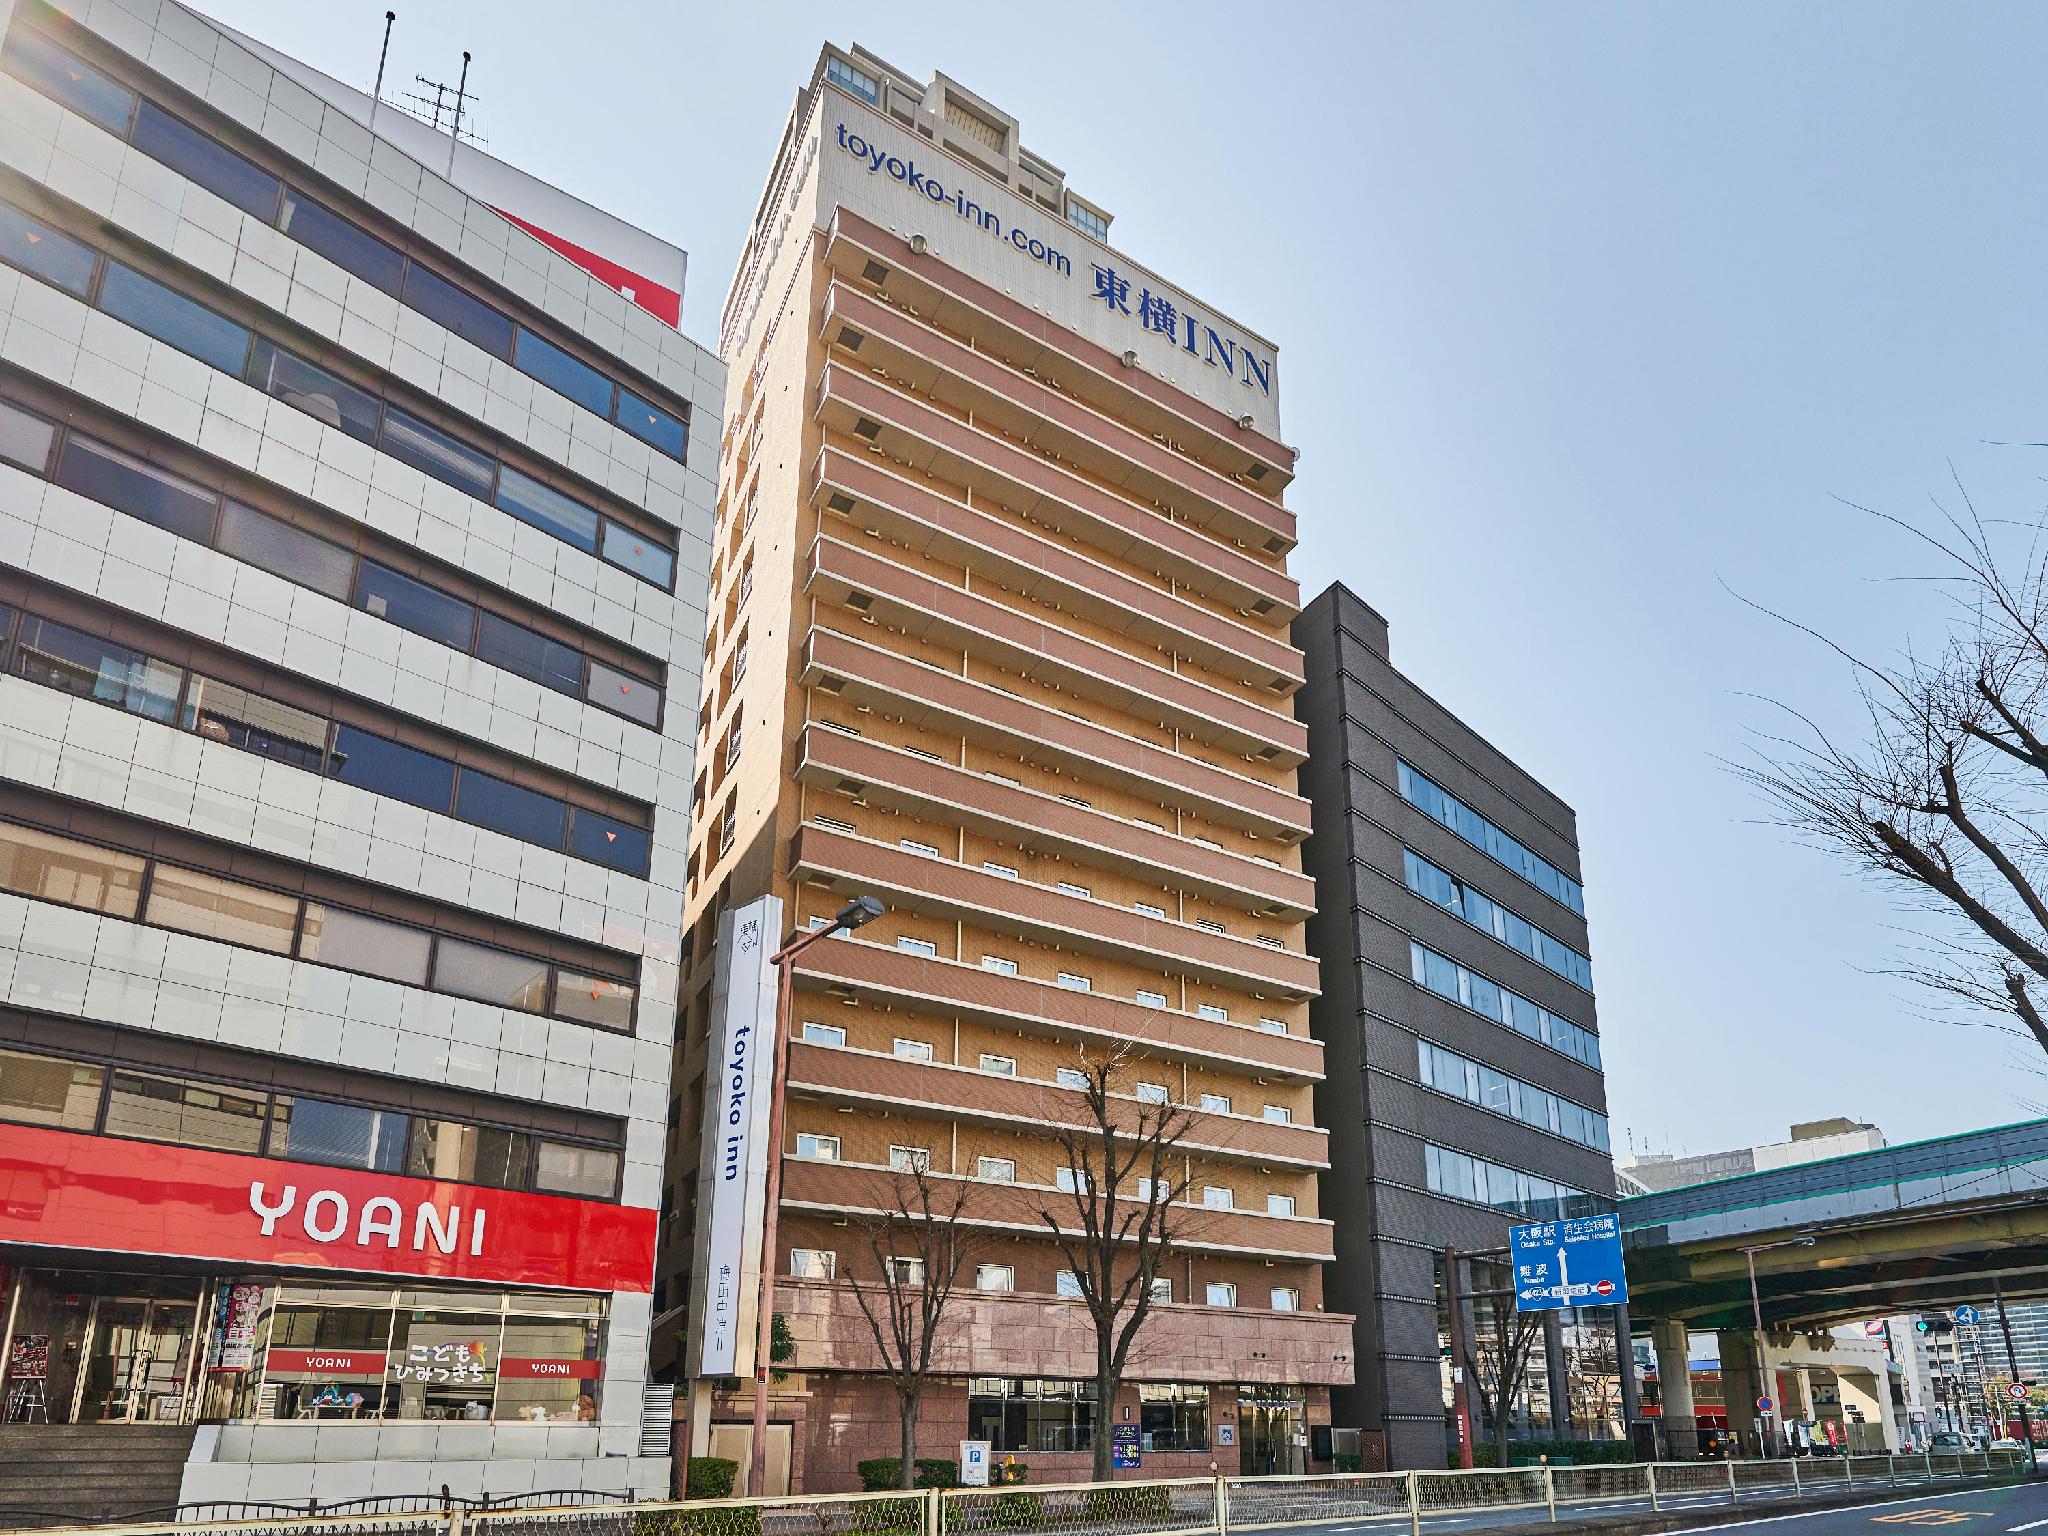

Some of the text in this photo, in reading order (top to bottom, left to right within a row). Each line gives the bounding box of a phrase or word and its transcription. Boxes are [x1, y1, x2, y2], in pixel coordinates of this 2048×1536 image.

[836, 123, 1071, 278] toyoko-inn.com
[725, 1025, 750, 1181] toyoko inn
[250, 1181, 486, 1256] YOANI
[1518, 1225, 1556, 1241] 大阪駅
[306, 1356, 351, 1368] YOANI
[410, 1344, 471, 1363] こども
[394, 1363, 484, 1383] ひみつきち
[531, 1363, 570, 1374] YOANI
